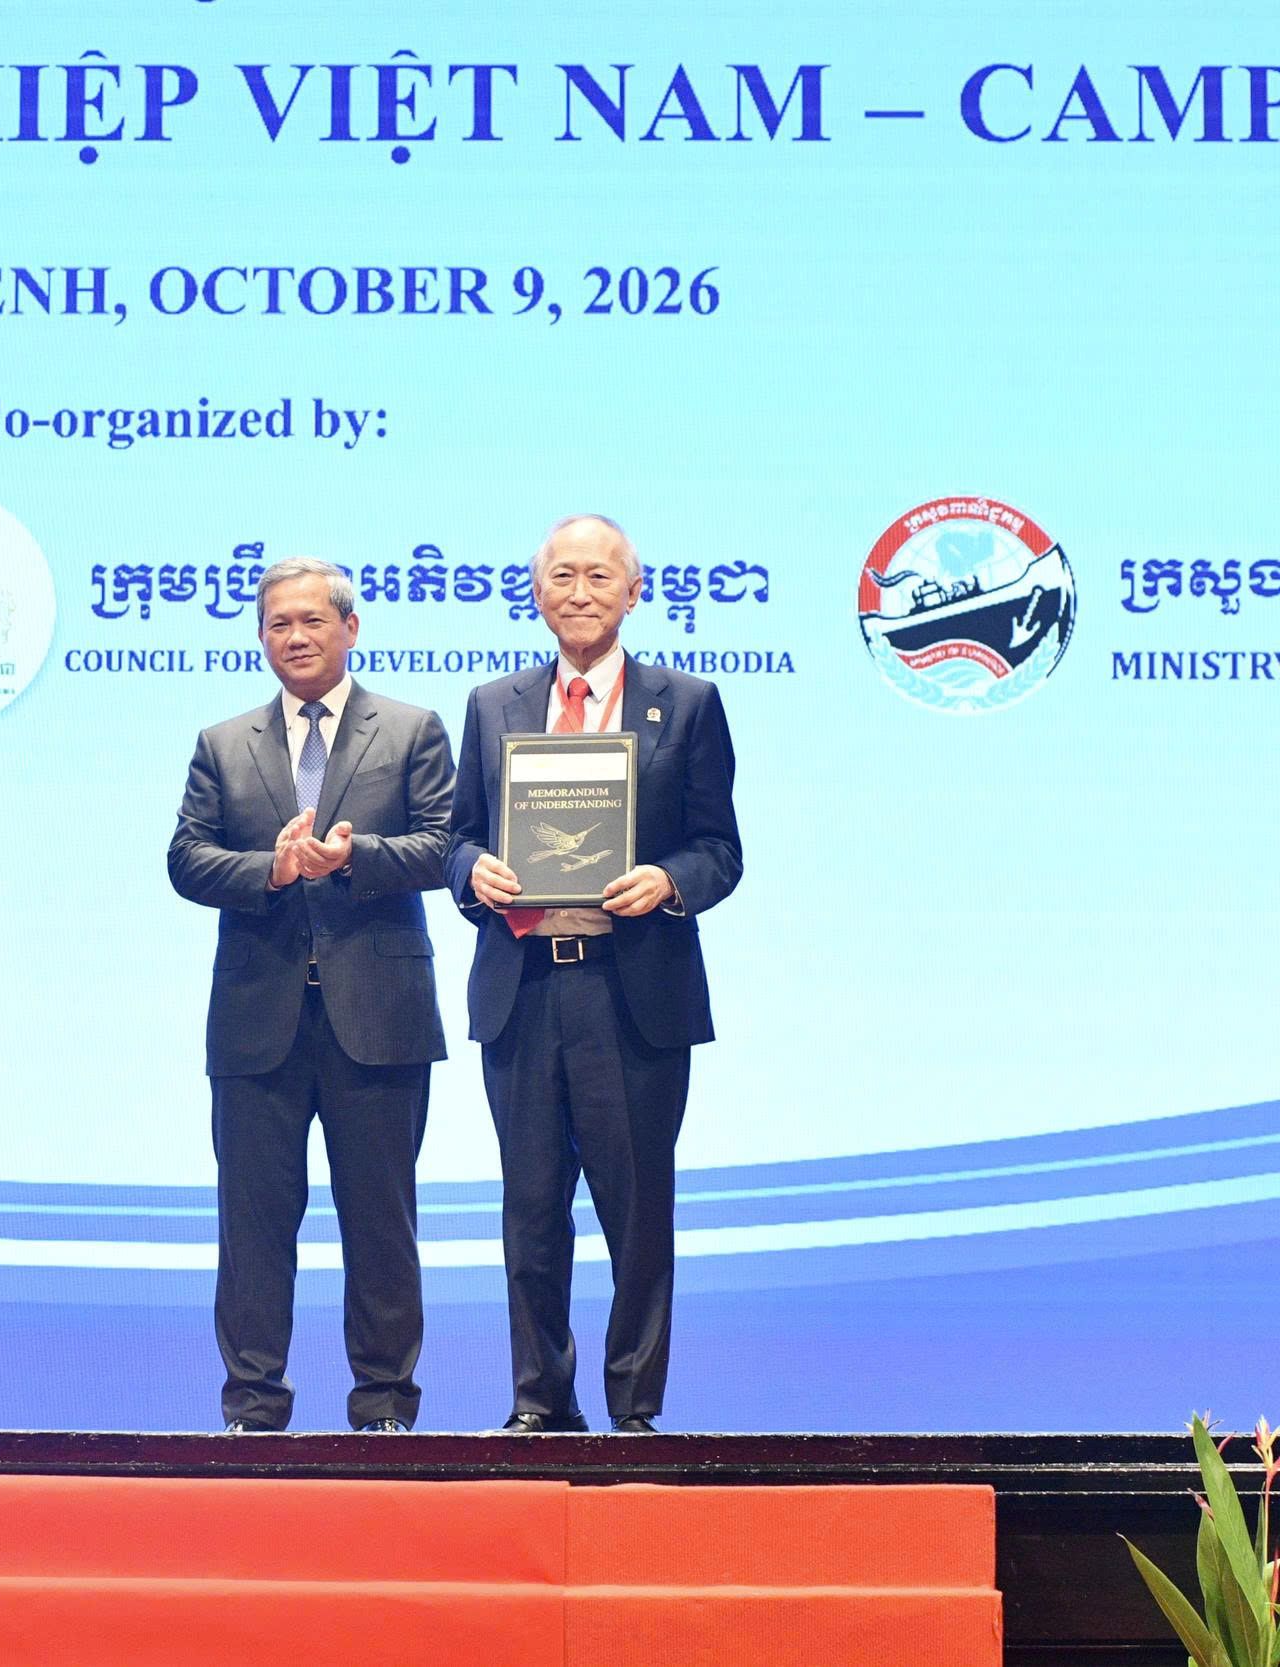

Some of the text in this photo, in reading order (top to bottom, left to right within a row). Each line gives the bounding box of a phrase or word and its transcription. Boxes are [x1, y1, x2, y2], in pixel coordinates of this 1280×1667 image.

[234, 50, 518, 165] VIỆT
[554, 63, 832, 143] NAM
[960, 63, 1280, 143] CAMP
[149, 267, 494, 316] OCTOBER
[512, 267, 563, 326] 9,
[583, 267, 720, 316] 2026
[313, 398, 387, 450] by:
[64, 650, 264, 673] COUNCIL FOR
[347, 650, 558, 673] DEVELOPMEN
[527, 787, 609, 798] MEMORANDUM
[514, 799, 622, 810] OF UNDERSTANDING
